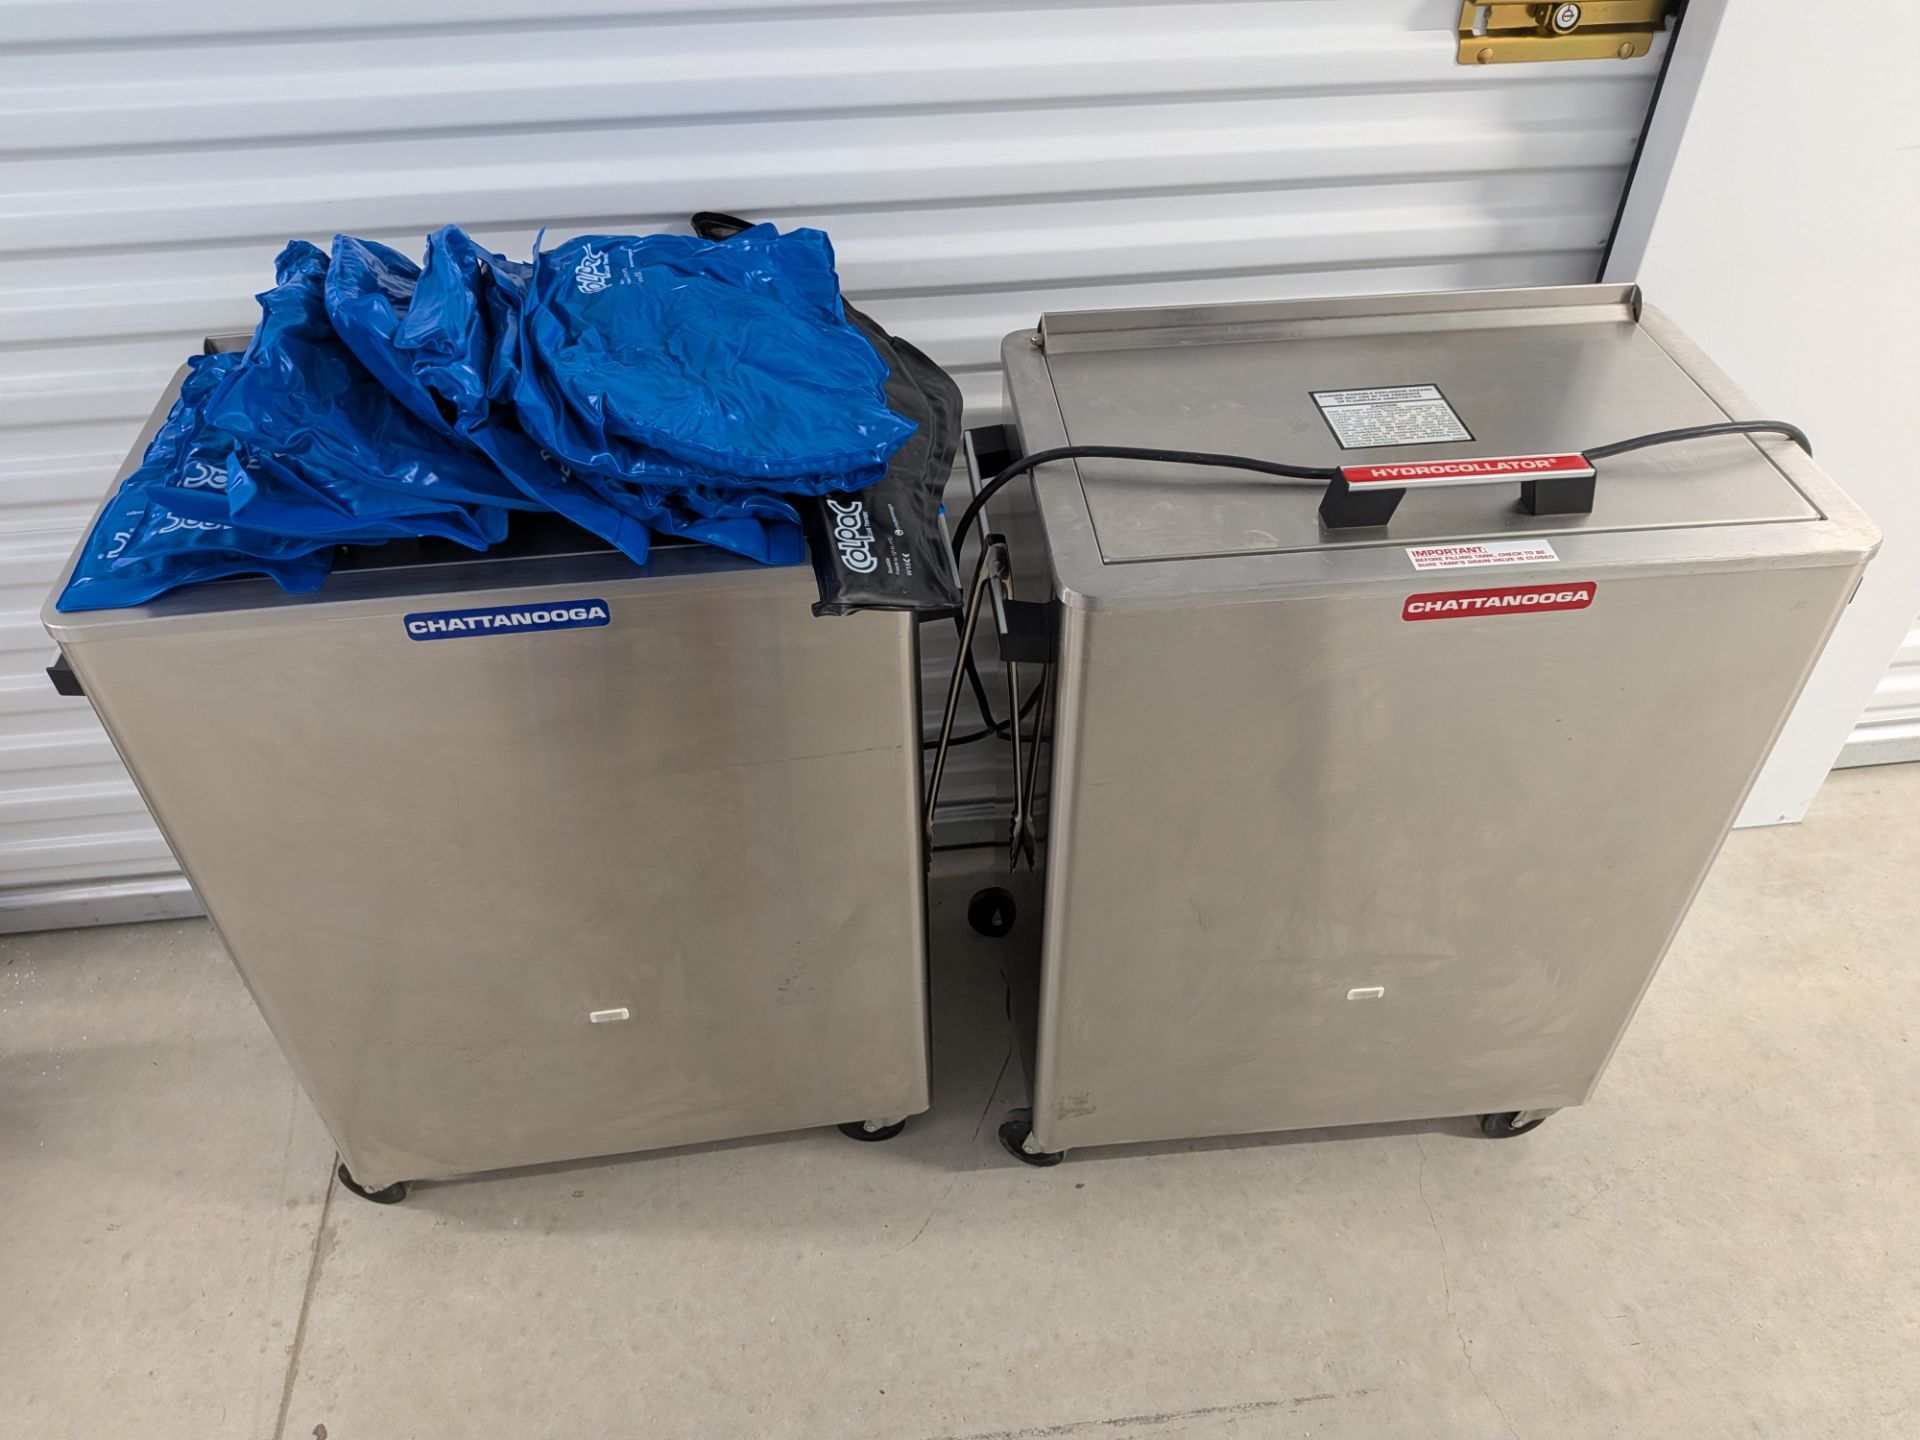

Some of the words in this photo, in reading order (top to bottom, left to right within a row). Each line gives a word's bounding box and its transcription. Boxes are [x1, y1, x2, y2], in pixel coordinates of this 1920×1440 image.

[1411, 546, 1488, 557] IMPORTANT:
[1407, 590, 1590, 614] CHATTANOOGA
[408, 606, 607, 634] CHATTANOOGA
